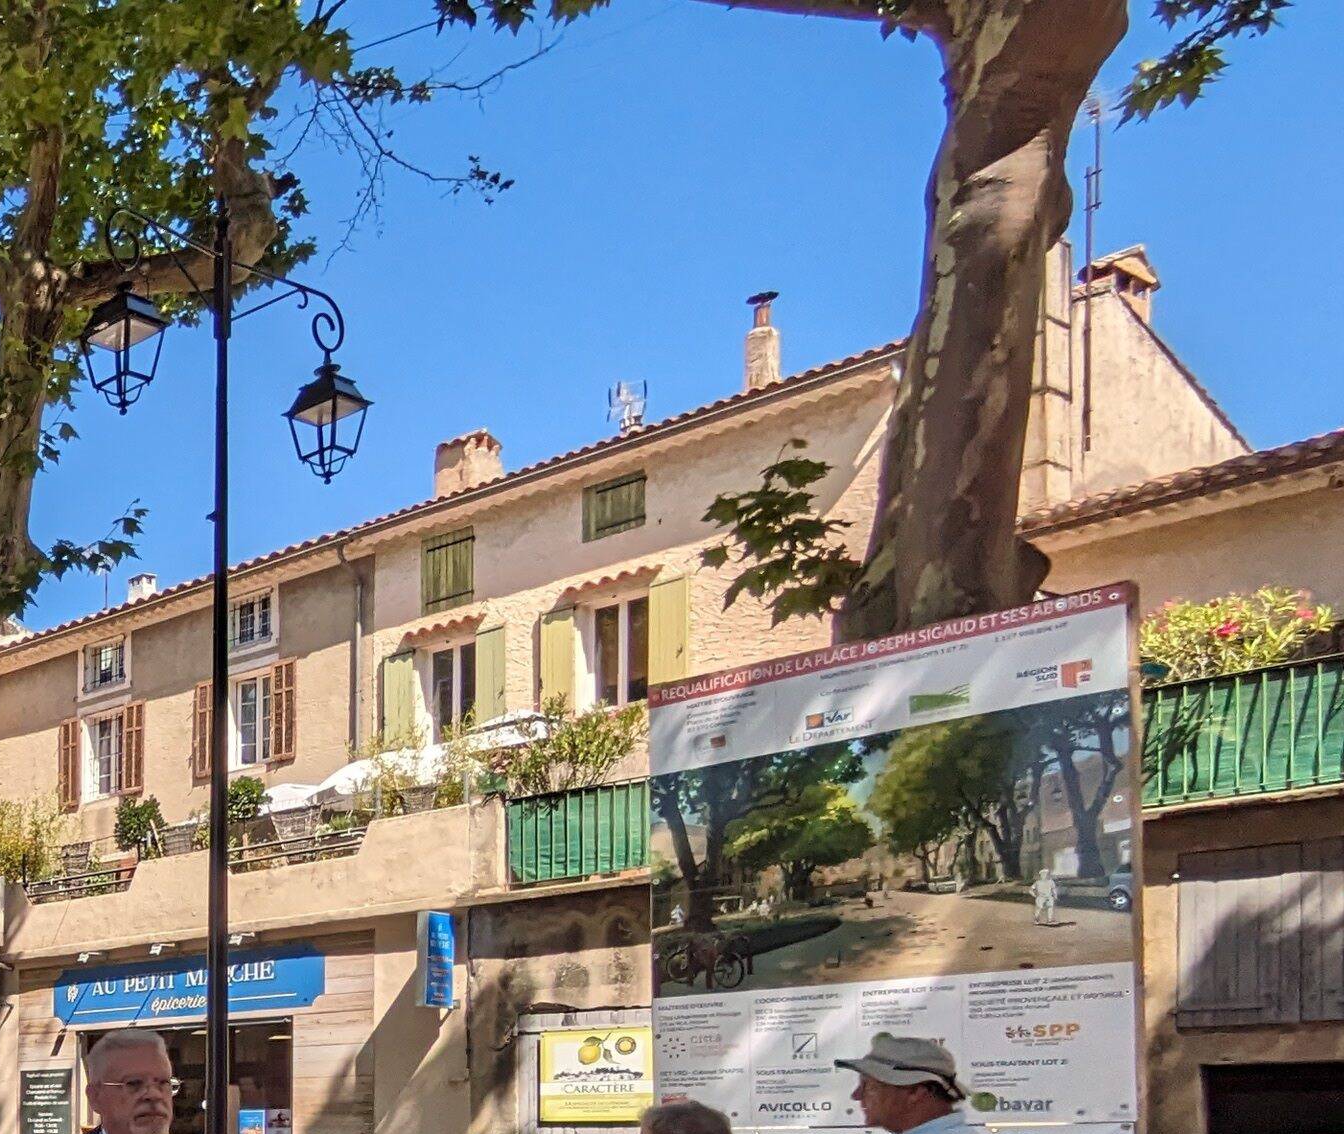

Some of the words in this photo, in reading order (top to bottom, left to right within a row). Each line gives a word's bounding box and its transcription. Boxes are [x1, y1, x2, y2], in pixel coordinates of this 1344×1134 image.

[661, 668, 773, 699] REQUALIFICATION
[775, 660, 794, 676] DE
[795, 656, 812, 671] LA
[814, 646, 858, 667] PLACE
[861, 631, 915, 657] JOSEPH
[918, 617, 976, 643] SIGAUD
[979, 612, 998, 629] ET
[1000, 606, 1029, 625] SES
[1029, 589, 1102, 618] ABORDS
[92, 978, 118, 997] AU
[123, 973, 175, 994] PETIT
[151, 995, 208, 1016] épicerie
[1032, 1022, 1080, 1038] SPP
[759, 1102, 832, 1112] AVICOLLO
